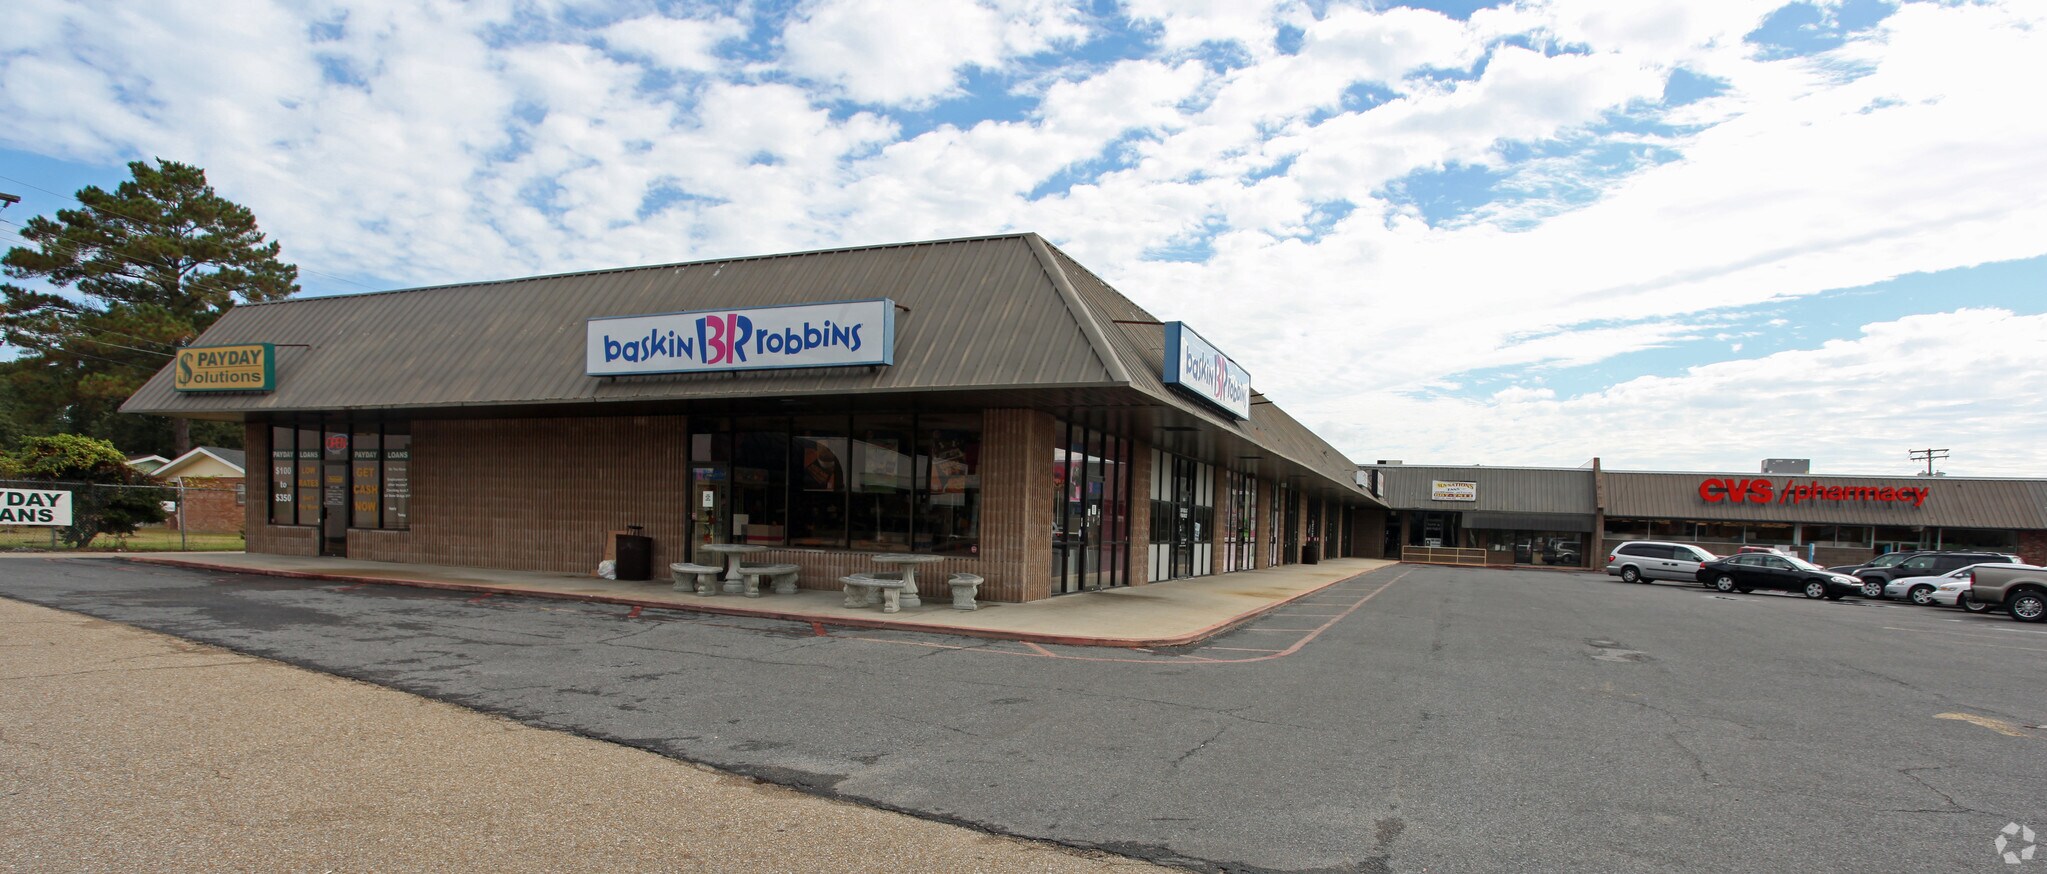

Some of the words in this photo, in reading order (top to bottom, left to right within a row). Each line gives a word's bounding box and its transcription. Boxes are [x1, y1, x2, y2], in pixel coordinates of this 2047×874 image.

[604, 328, 693, 363] baskin
[695, 314, 753, 364] BR
[756, 320, 862, 355] robbins
[197, 349, 262, 366] PAYDAY
[1186, 345, 1213, 388] baskin
[1213, 353, 1229, 401] BR
[1228, 377, 1248, 409] robbins
[327, 437, 347, 449] OPEN
[354, 451, 377, 459] PAYDAY
[387, 451, 408, 459] LOANS
[275, 467, 292, 475] $100
[302, 466, 316, 474] LOW
[356, 467, 375, 478] GET
[299, 479, 320, 487] RATES
[353, 484, 379, 495] CASH
[1699, 477, 1773, 504] CVS
[0, 492, 63, 508] DAY
[275, 493, 292, 502] $350
[354, 501, 377, 512] NOW
